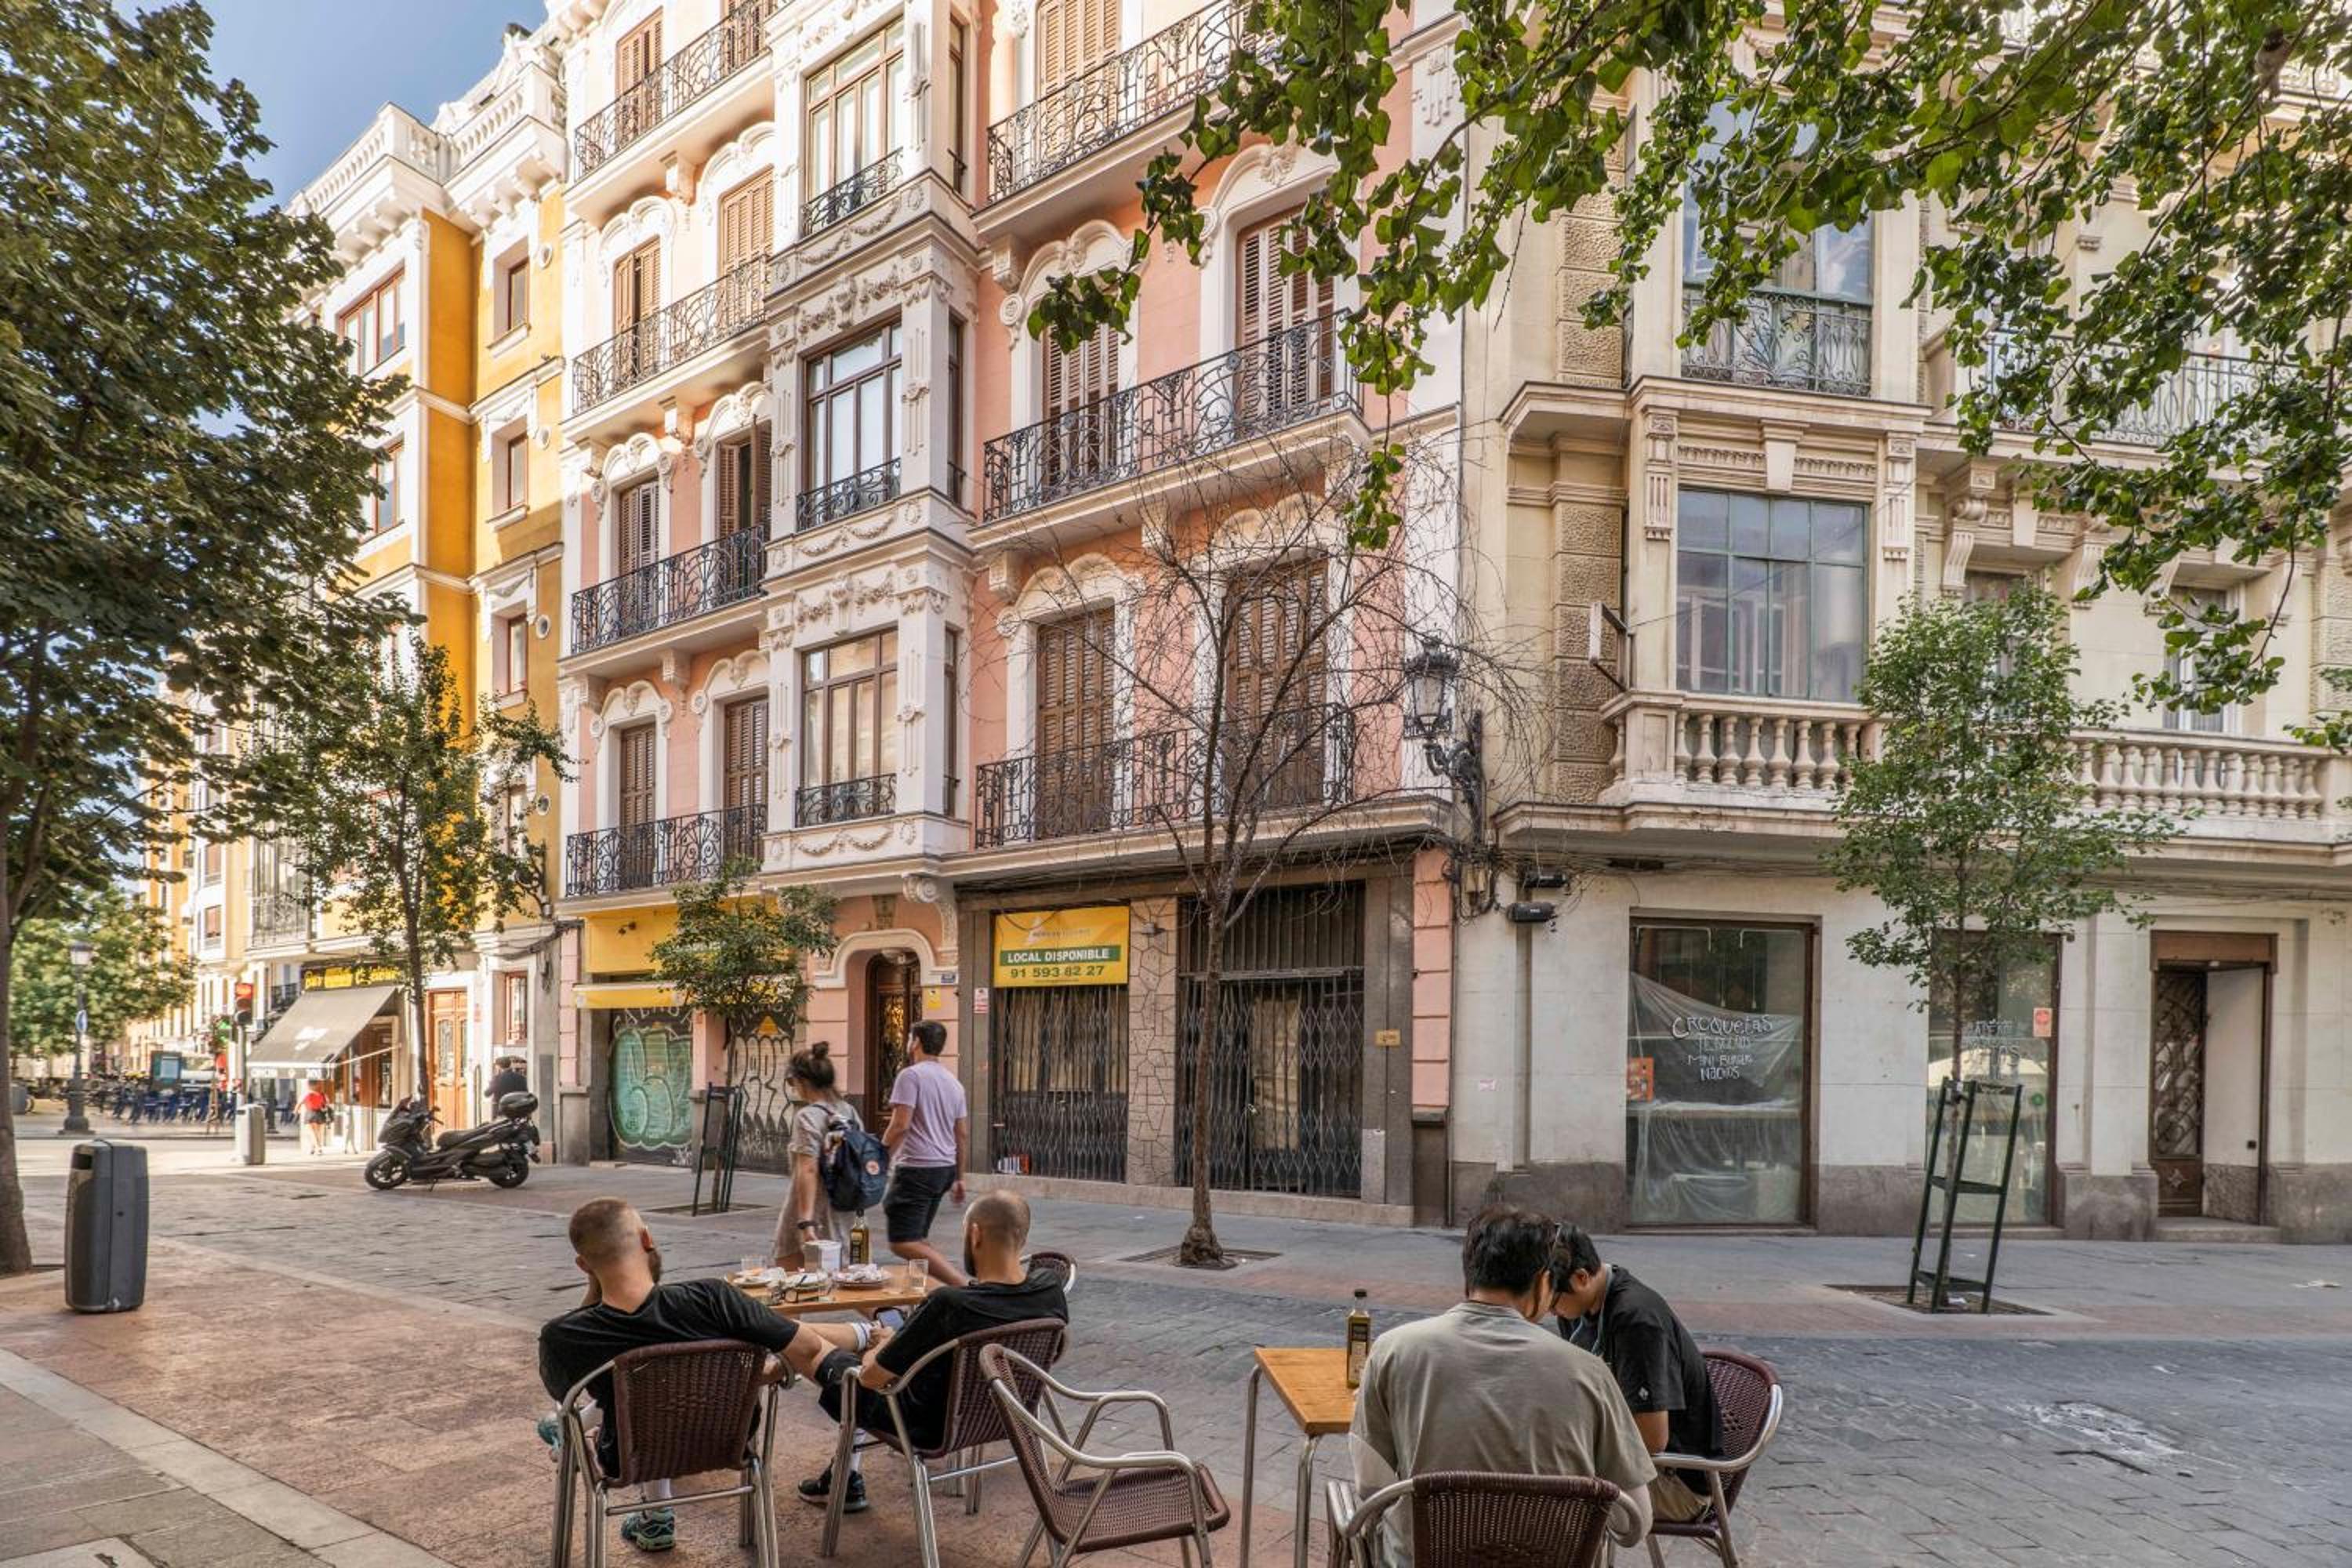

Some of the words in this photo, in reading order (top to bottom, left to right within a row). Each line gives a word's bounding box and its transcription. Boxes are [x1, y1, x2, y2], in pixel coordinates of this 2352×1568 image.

[1007, 951, 1042, 964] LOCAL
[1044, 947, 1110, 962] DISPONIBLE
[1010, 967, 1026, 979] 91
[1032, 966, 1059, 978] 593
[1086, 964, 1105, 977] 27
